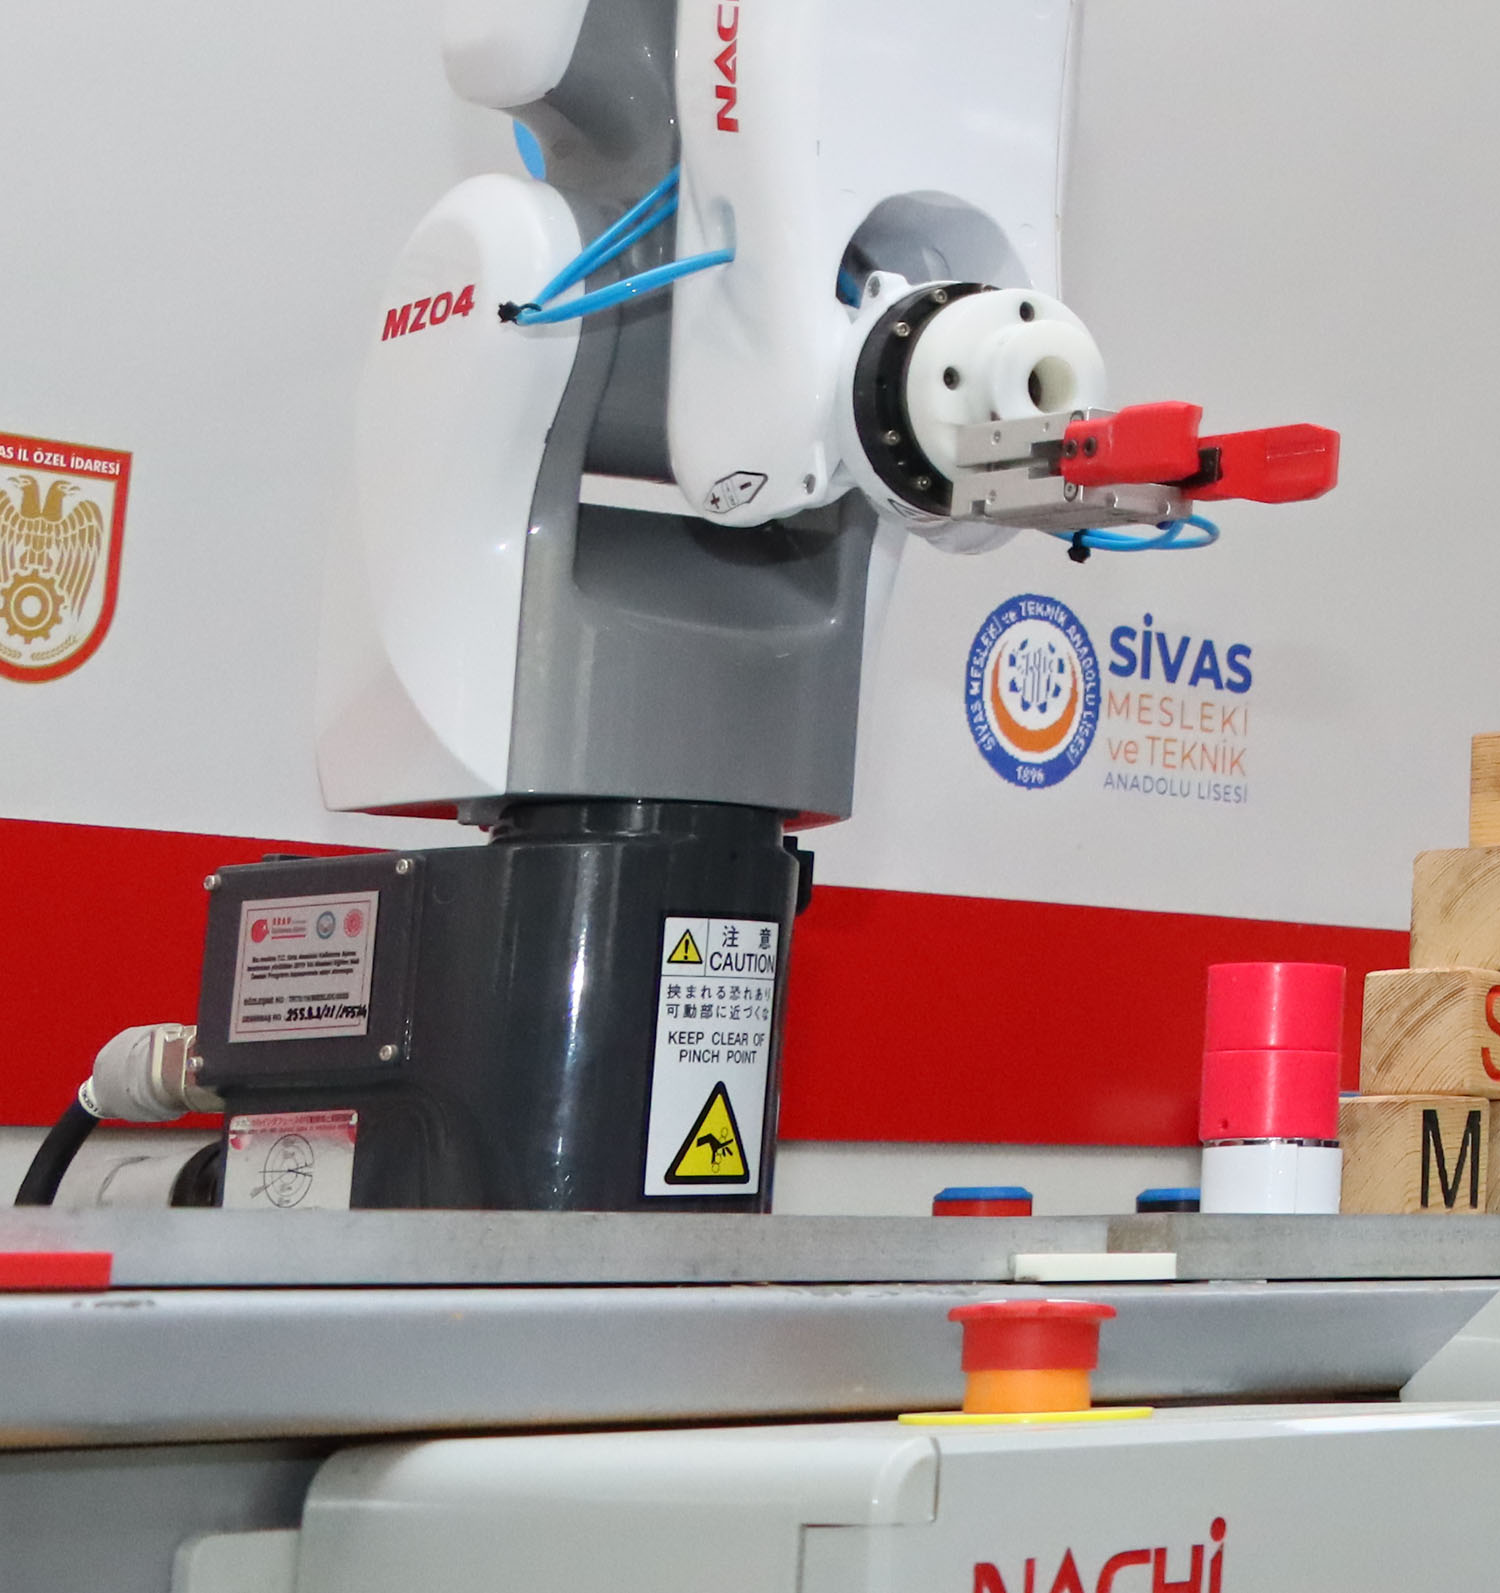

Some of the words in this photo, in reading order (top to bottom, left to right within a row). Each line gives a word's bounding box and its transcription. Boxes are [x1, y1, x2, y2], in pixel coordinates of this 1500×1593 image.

[33, 448, 67, 467] ÖZEL
[1108, 612, 1253, 694] SİVAS
[1145, 735, 1248, 777] TEKNİK
[1103, 771, 1191, 798] ANADOLU
[709, 951, 775, 974] CAUTION
[668, 1031, 705, 1046] KEEP
[711, 1031, 749, 1047] CLEAR
[753, 1033, 765, 1047] OF
[679, 1049, 720, 1064] PINCH
[726, 1050, 757, 1065] POINT
